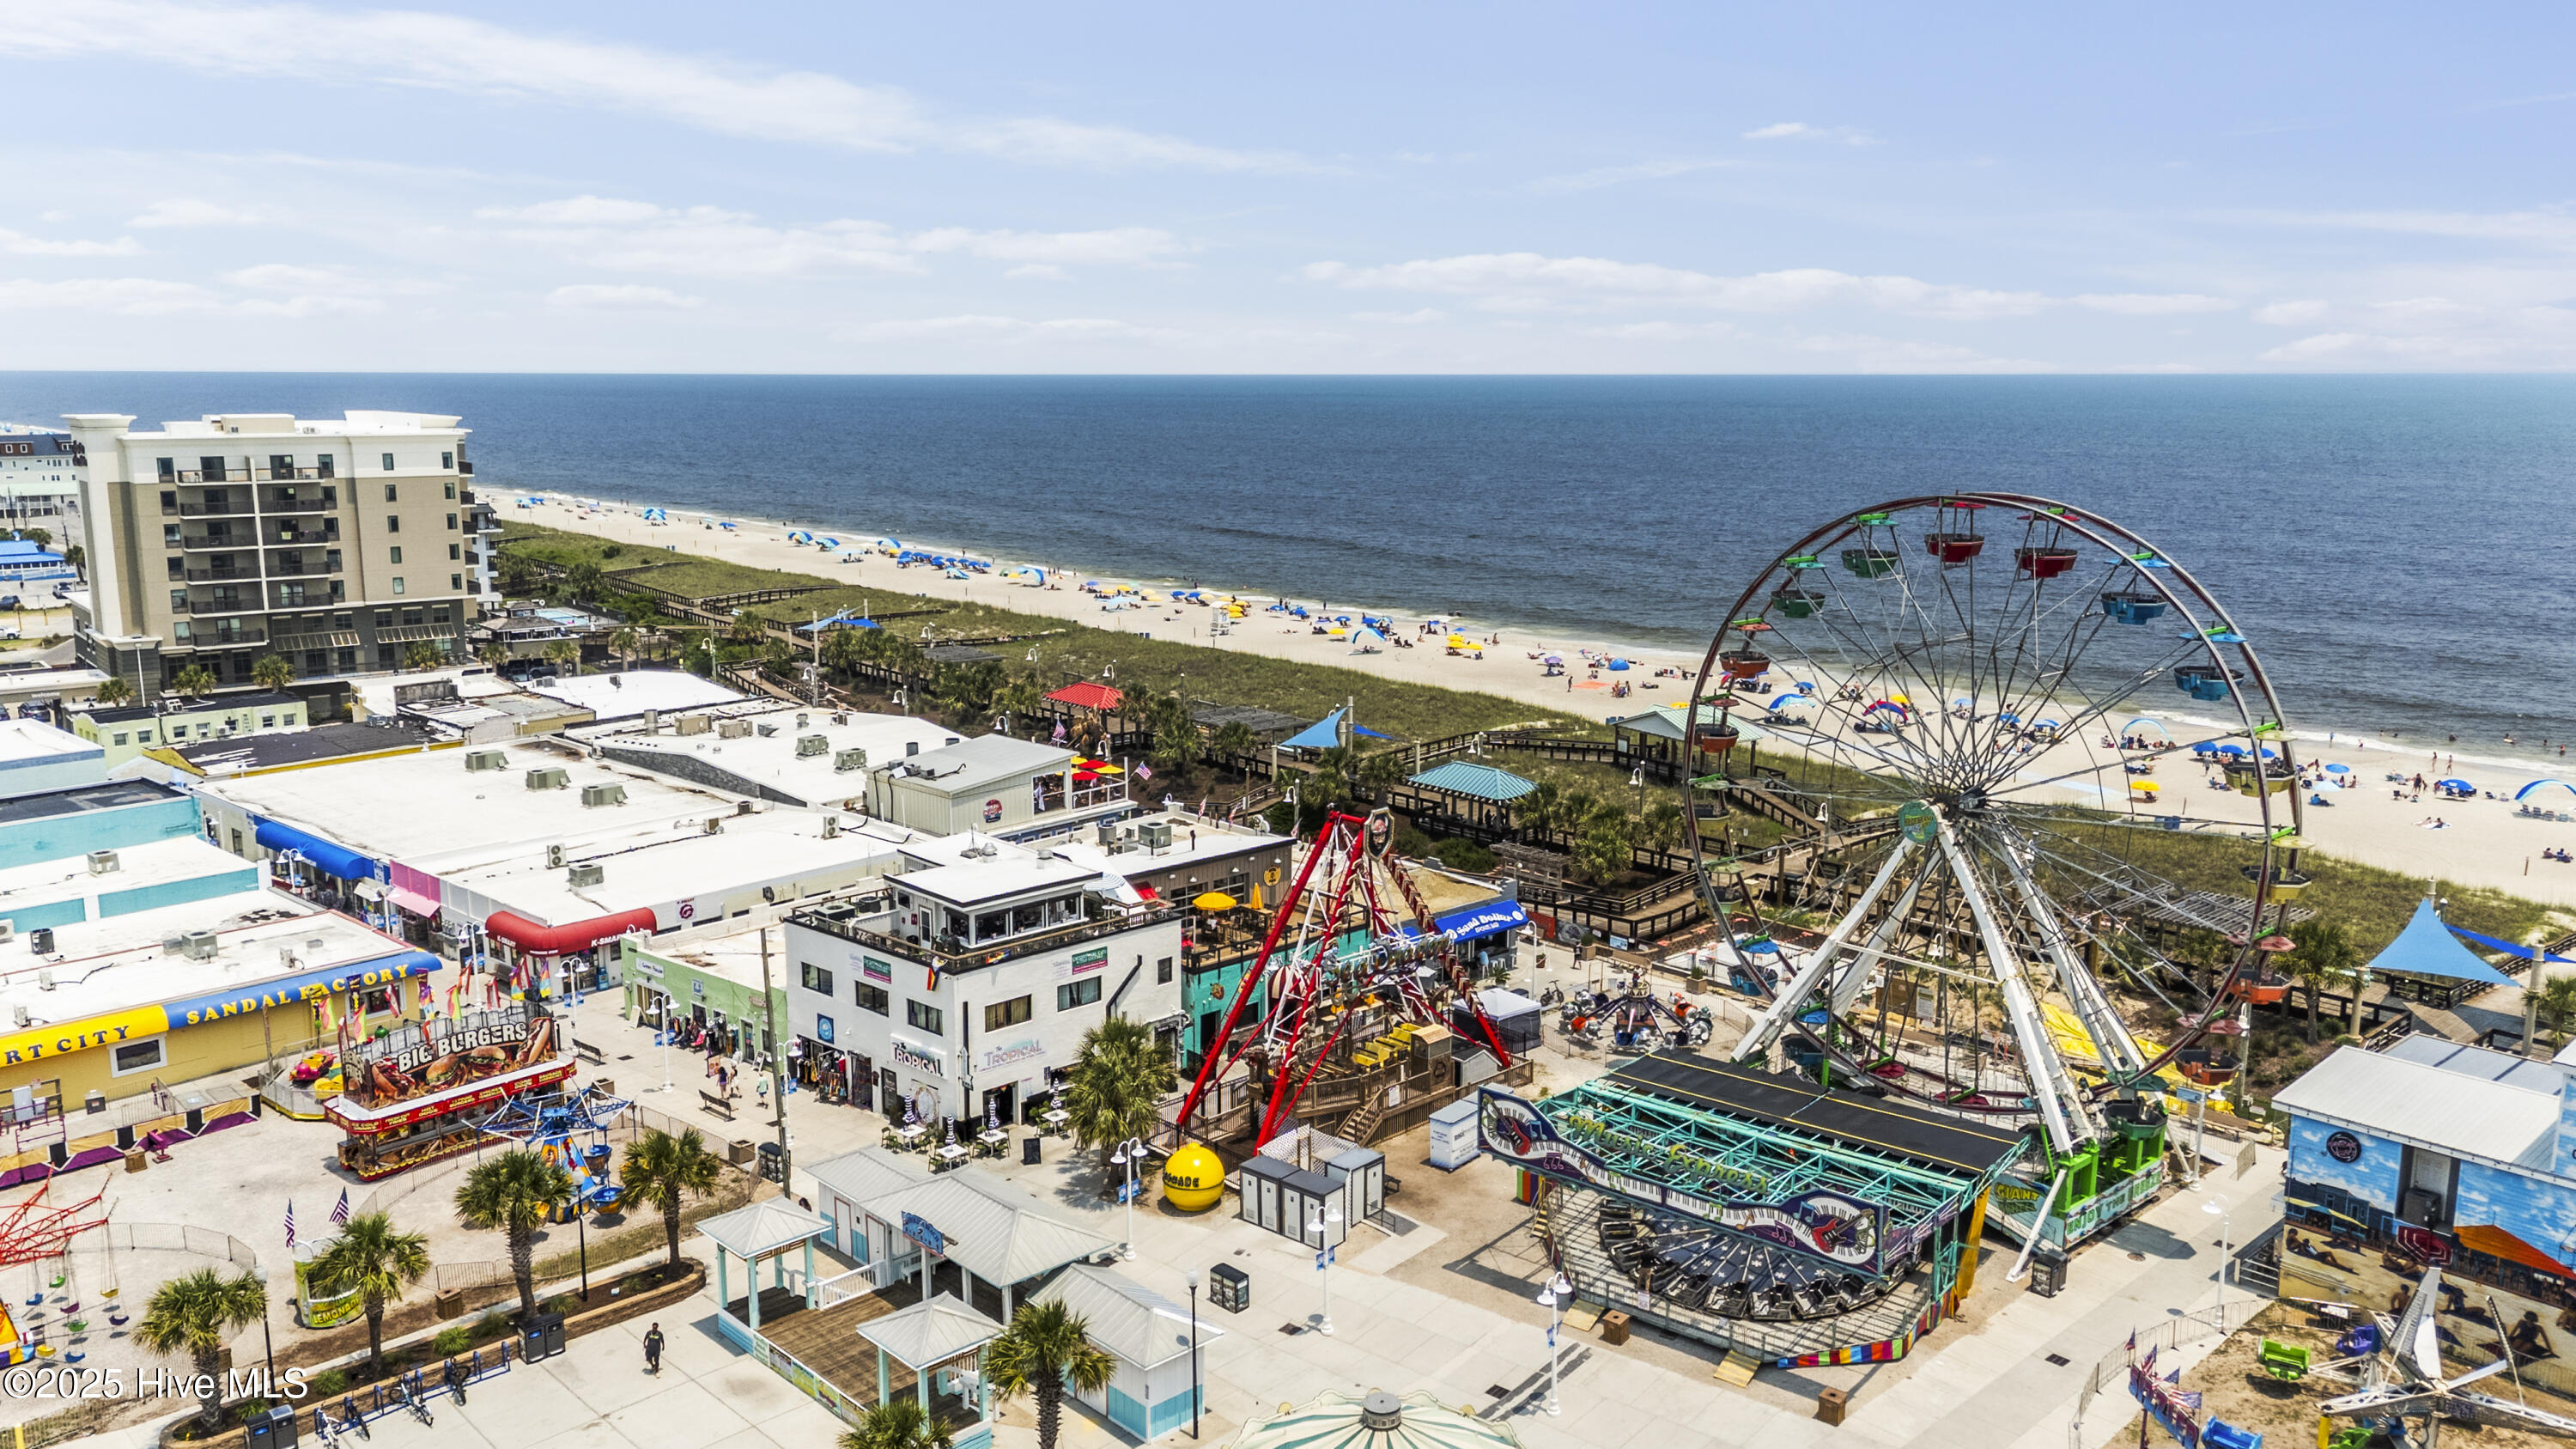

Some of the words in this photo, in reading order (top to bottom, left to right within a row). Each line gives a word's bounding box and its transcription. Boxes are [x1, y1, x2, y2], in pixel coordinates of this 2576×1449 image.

[1456, 917, 1480, 936] Sand
[1478, 912, 1513, 924] Dollar
[185, 990, 293, 1026] SANDAL
[298, 963, 410, 1001] FACORY
[56, 1025, 131, 1055] CITY
[398, 1044, 434, 1074] BIG
[437, 1022, 528, 1058] BURGERS
[983, 1038, 1044, 1067] TROPICAL
[891, 1042, 944, 1077] TROPICAL
[419, 1108, 439, 1117] DOGS
[1569, 1117, 1656, 1160] Music
[1662, 1143, 1771, 1196] Express
[1996, 1183, 2040, 1202] GIANT
[2066, 1203, 2102, 1235] ENJOY
